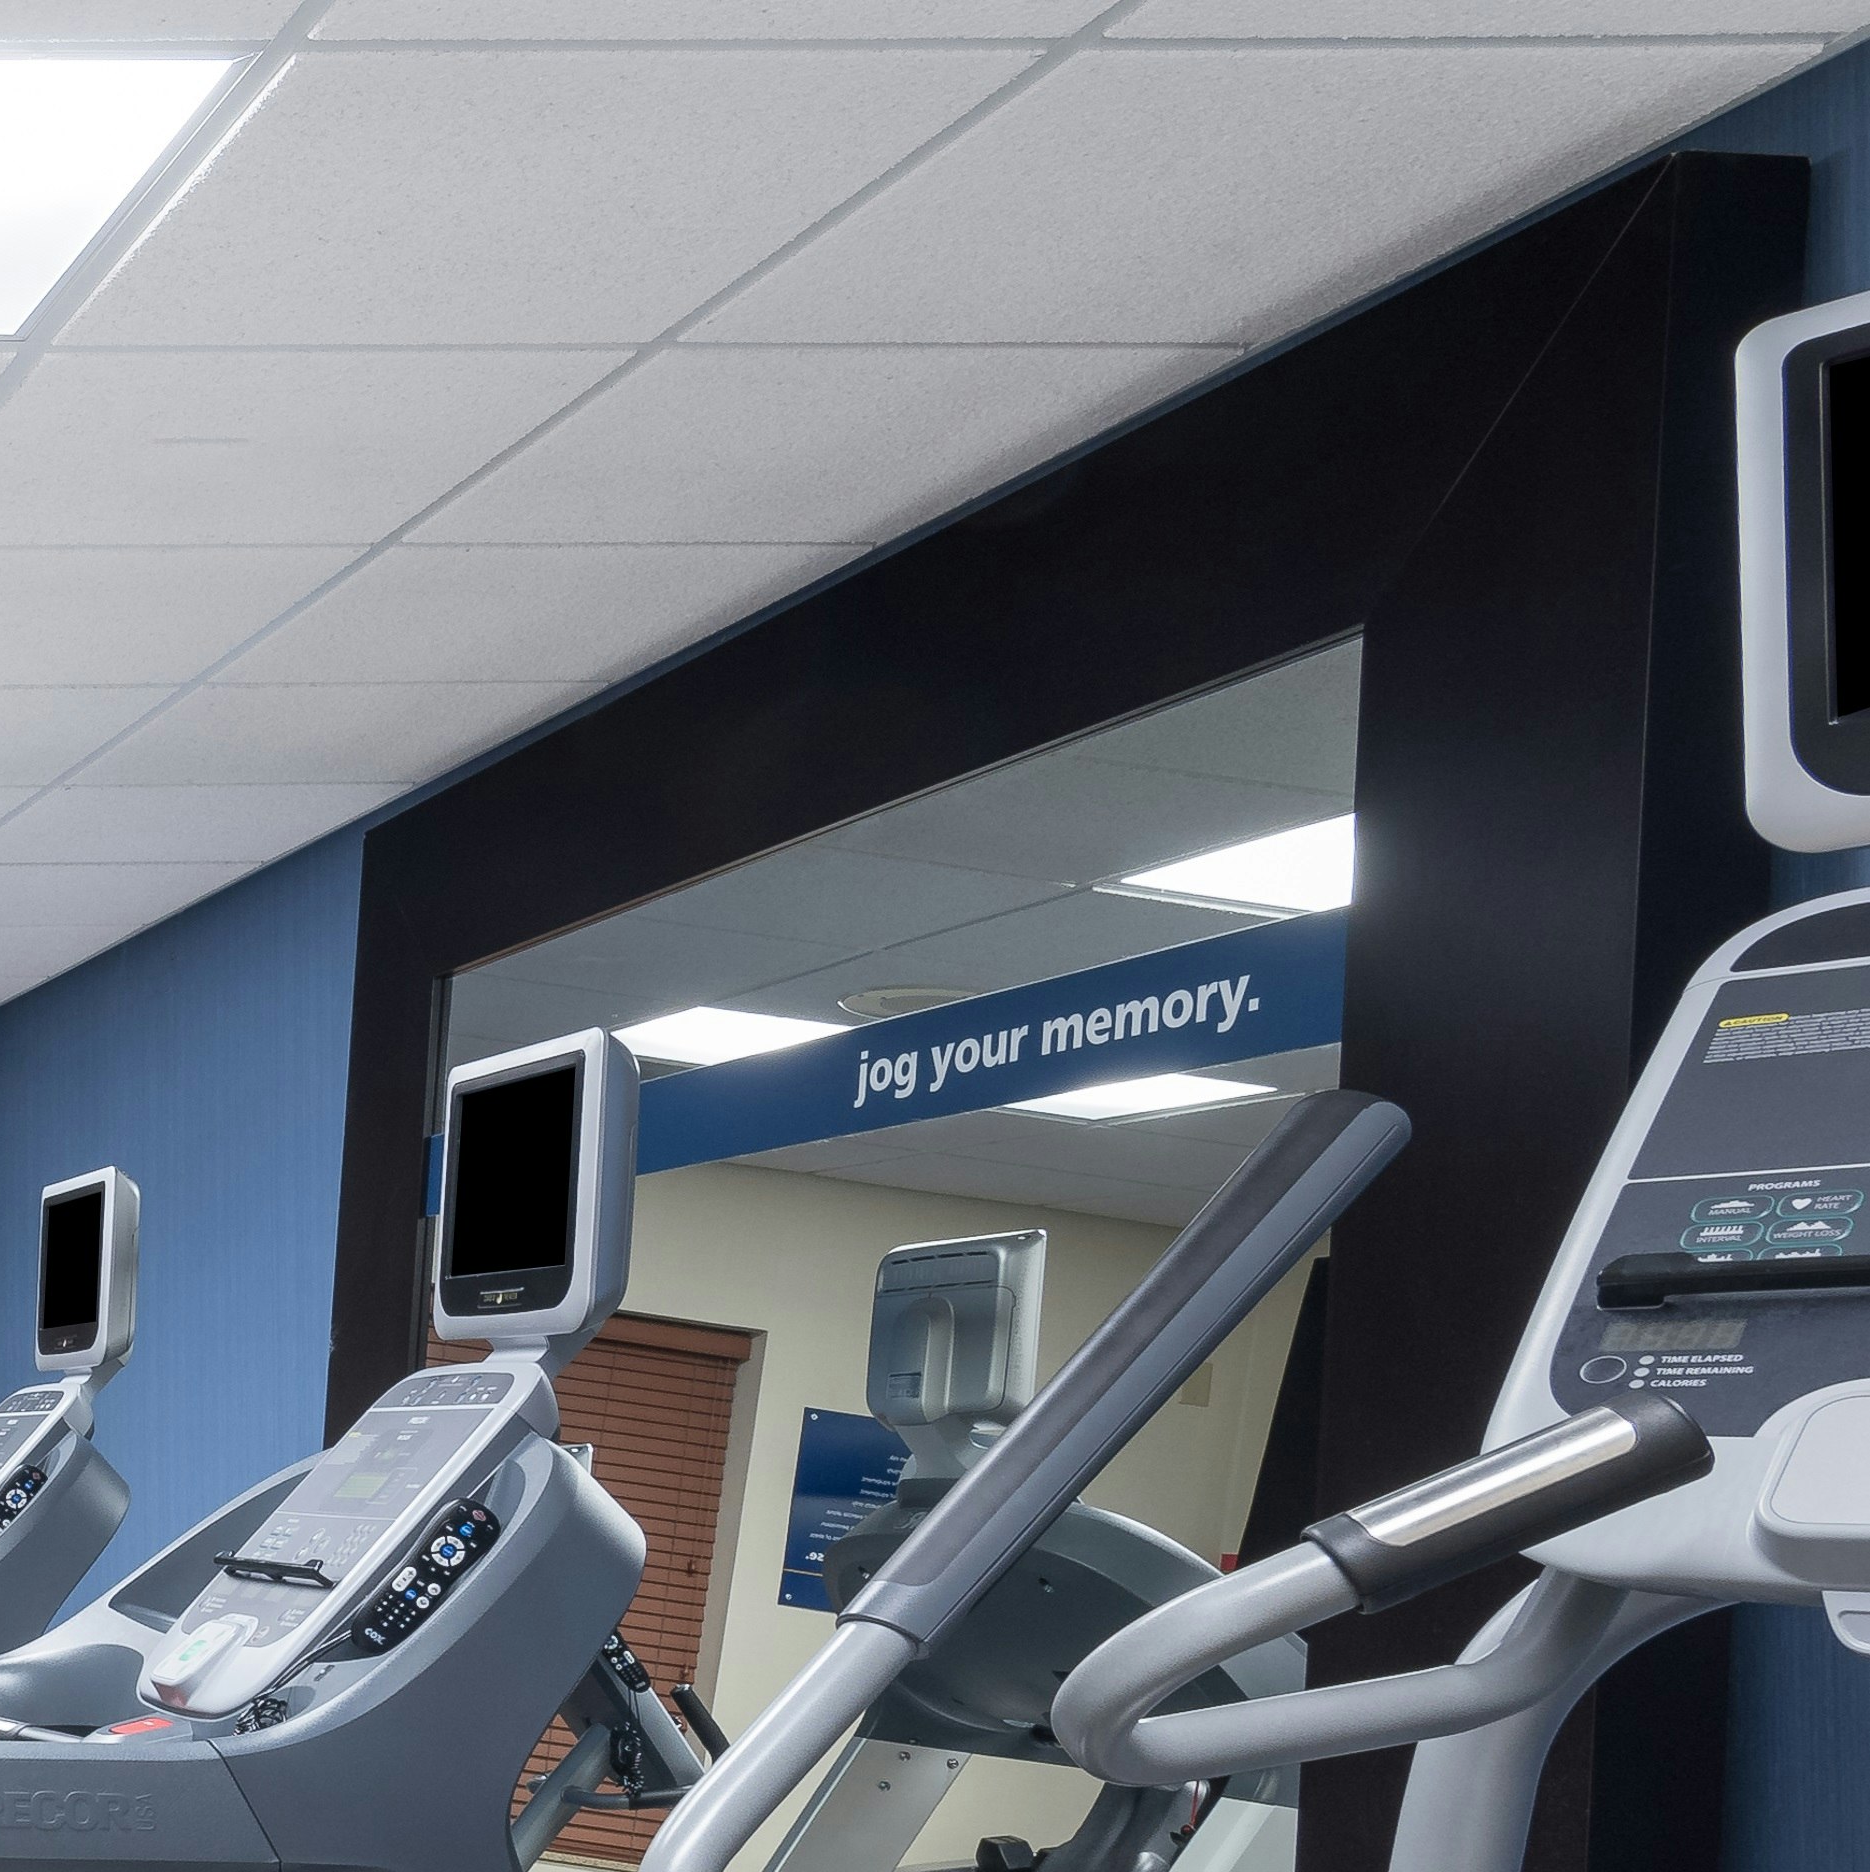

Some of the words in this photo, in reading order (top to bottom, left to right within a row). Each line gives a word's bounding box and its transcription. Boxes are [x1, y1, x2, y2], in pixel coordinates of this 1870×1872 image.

[853, 1050, 917, 1108] jog
[928, 1023, 1029, 1093] your
[1040, 973, 1261, 1056] memory.
[1748, 1179, 1821, 1191] PROGRAMS
[1816, 1194, 1853, 1202] HEART
[1813, 1202, 1840, 1210] RATE
[1708, 1207, 1752, 1216] MANUAL
[1695, 1234, 1743, 1243] INTERVAL
[1773, 1231, 1812, 1239] WEIGHT
[1814, 1229, 1843, 1237] LOSS
[1661, 1355, 1689, 1363] TIME
[1690, 1354, 1744, 1363] ELAPSED
[1656, 1367, 1684, 1375] TIME
[1685, 1366, 1754, 1375] REMAINING
[1649, 1379, 1708, 1388] CALORIES
